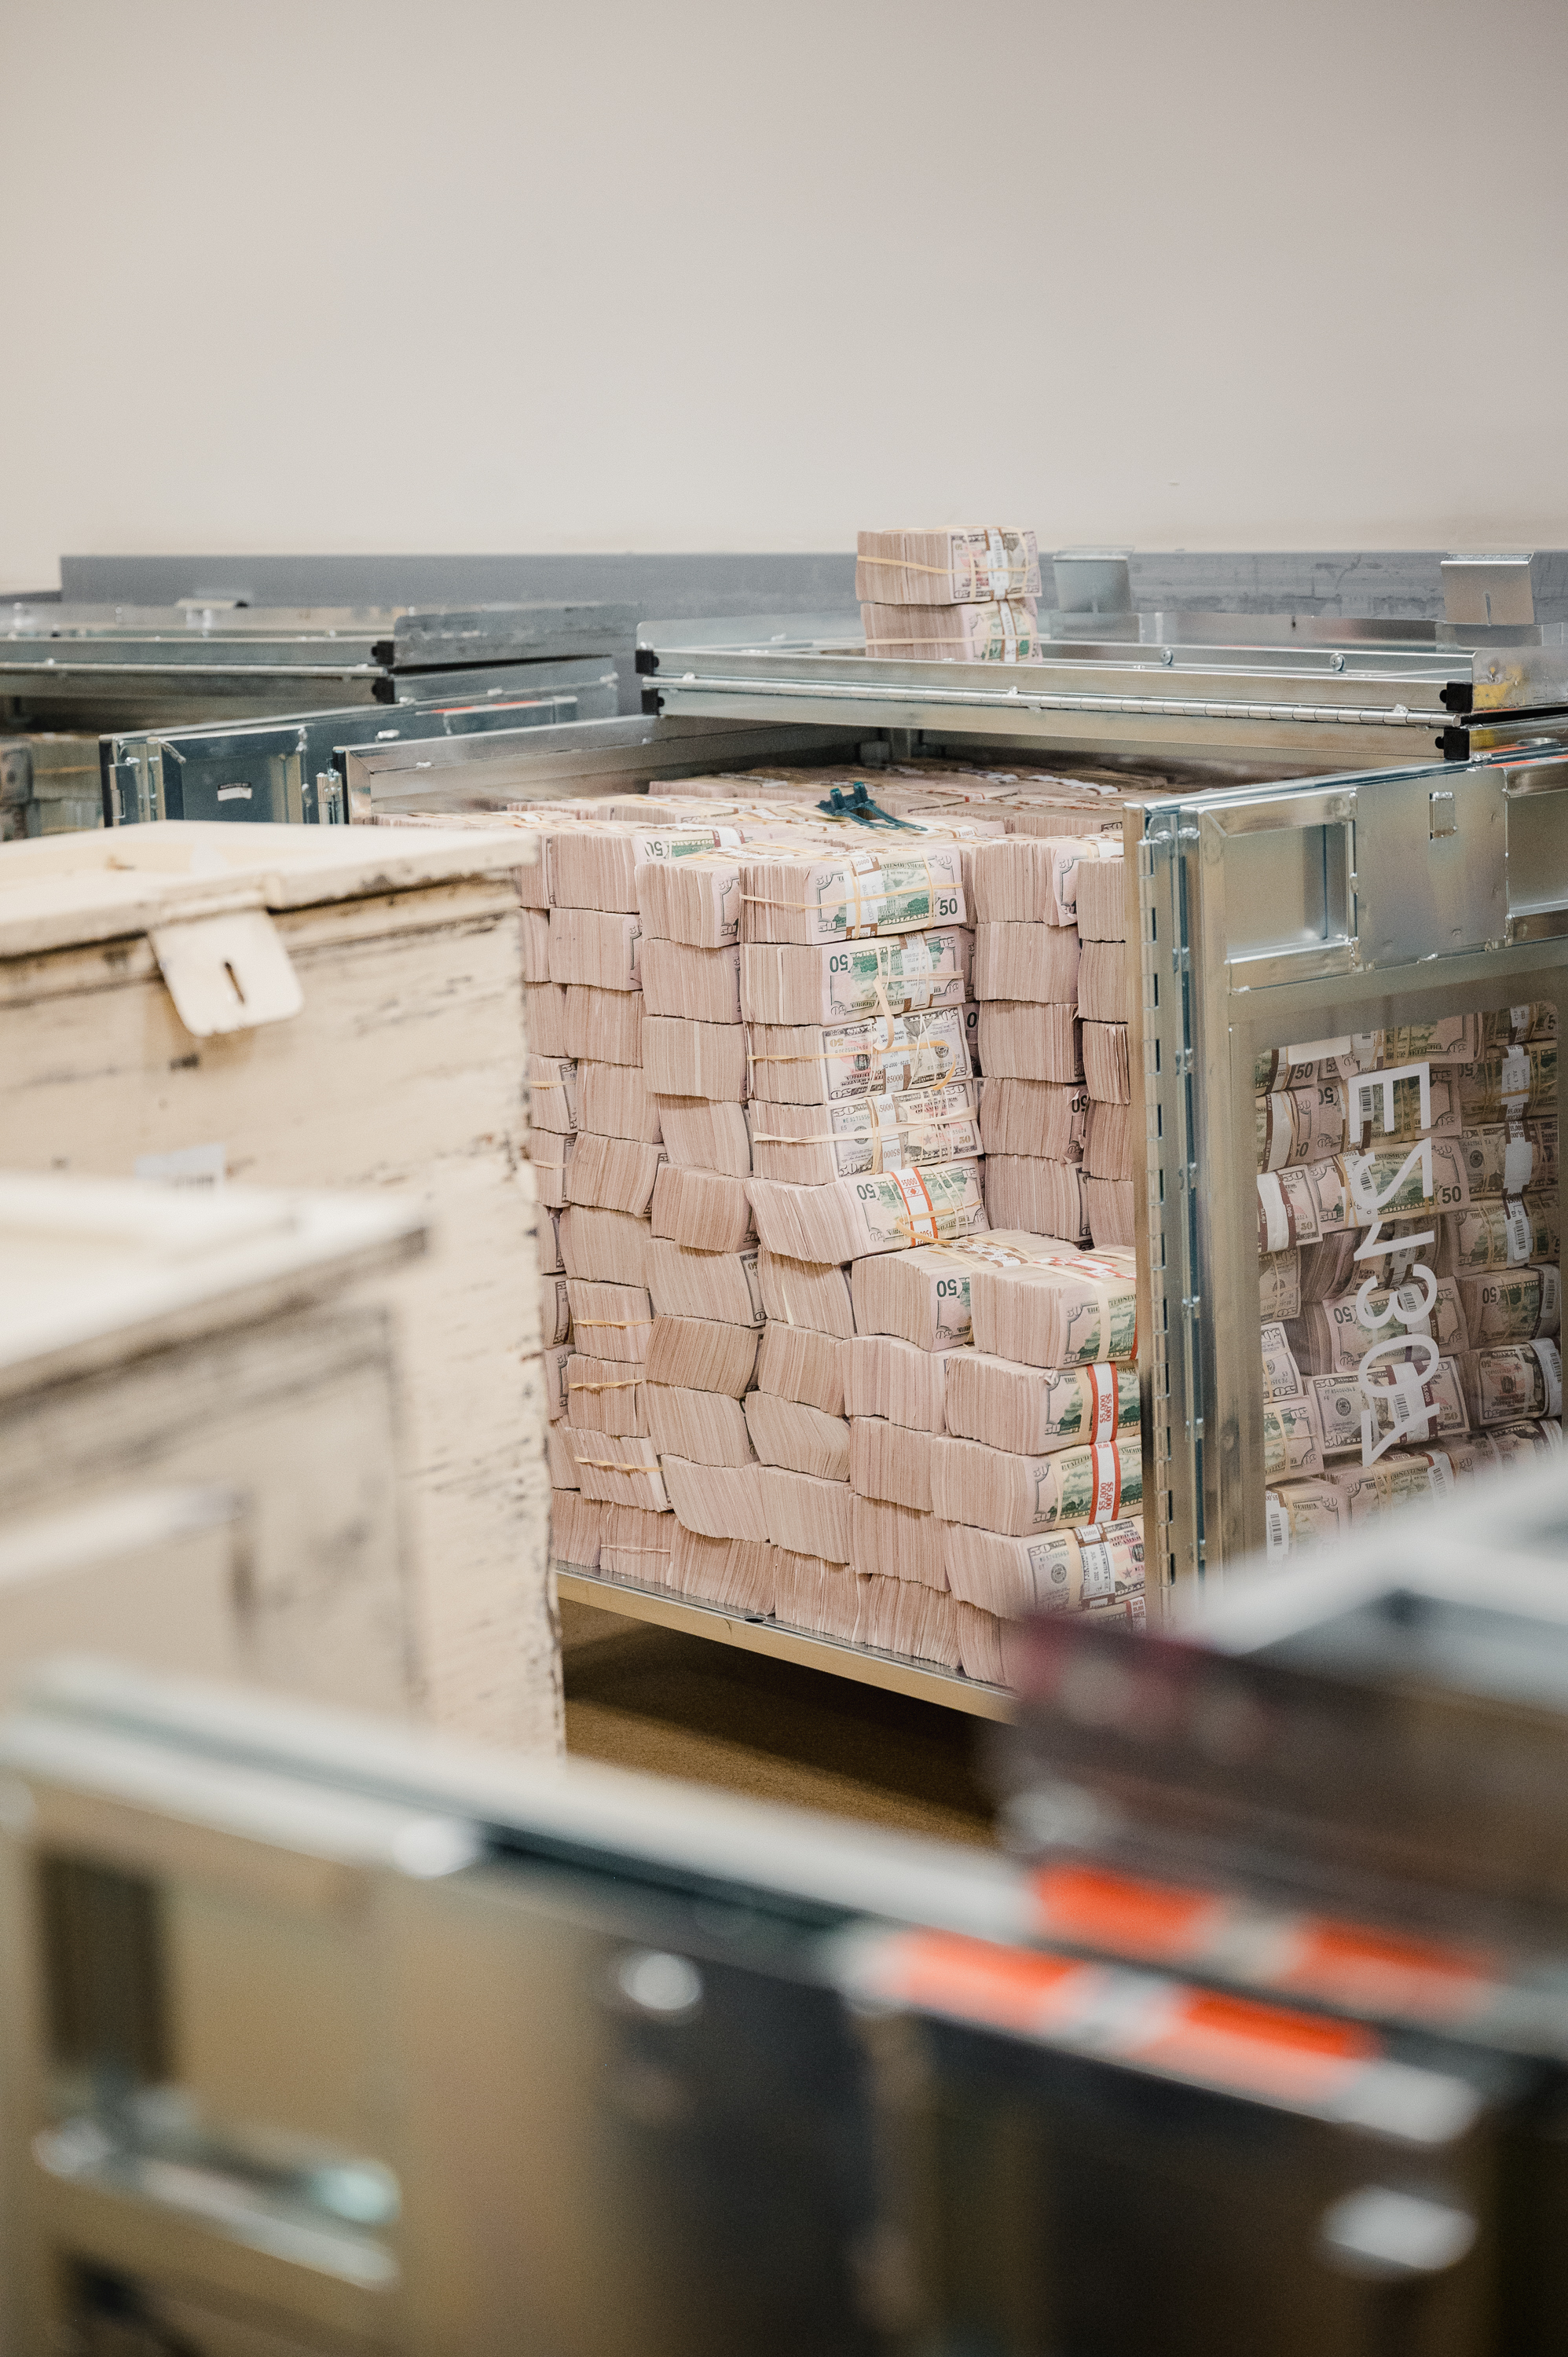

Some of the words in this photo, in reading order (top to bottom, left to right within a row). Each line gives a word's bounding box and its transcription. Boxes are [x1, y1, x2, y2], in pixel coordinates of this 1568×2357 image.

[939, 898, 958, 915] 50
[819, 922, 837, 932] 50
[830, 955, 848, 973] 50
[967, 1012, 977, 1028] 0
[830, 1038, 844, 1047] 50
[1295, 1062, 1313, 1080] 50
[886, 1073, 903, 1083] $5000
[831, 1088, 851, 1099] 50
[945, 1085, 965, 1094] 50
[833, 1107, 855, 1116] 50
[958, 1135, 971, 1144] 50
[884, 1149, 900, 1158] $5000
[839, 1163, 857, 1175] 50
[1283, 1171, 1303, 1182] 50
[856, 1183, 876, 1200] 50
[1442, 1186, 1462, 1204] 50
[1321, 1211, 1338, 1222] 50
[1301, 1222, 1313, 1230] 50
[936, 1279, 958, 1297] 50
[1482, 1287, 1497, 1303] 50
[1334, 1306, 1353, 1324] 50
[1316, 1379, 1335, 1387] 50
[1274, 1384, 1295, 1396] 50
[1324, 1435, 1343, 1447] 50
[1031, 1544, 1052, 1556] 50
